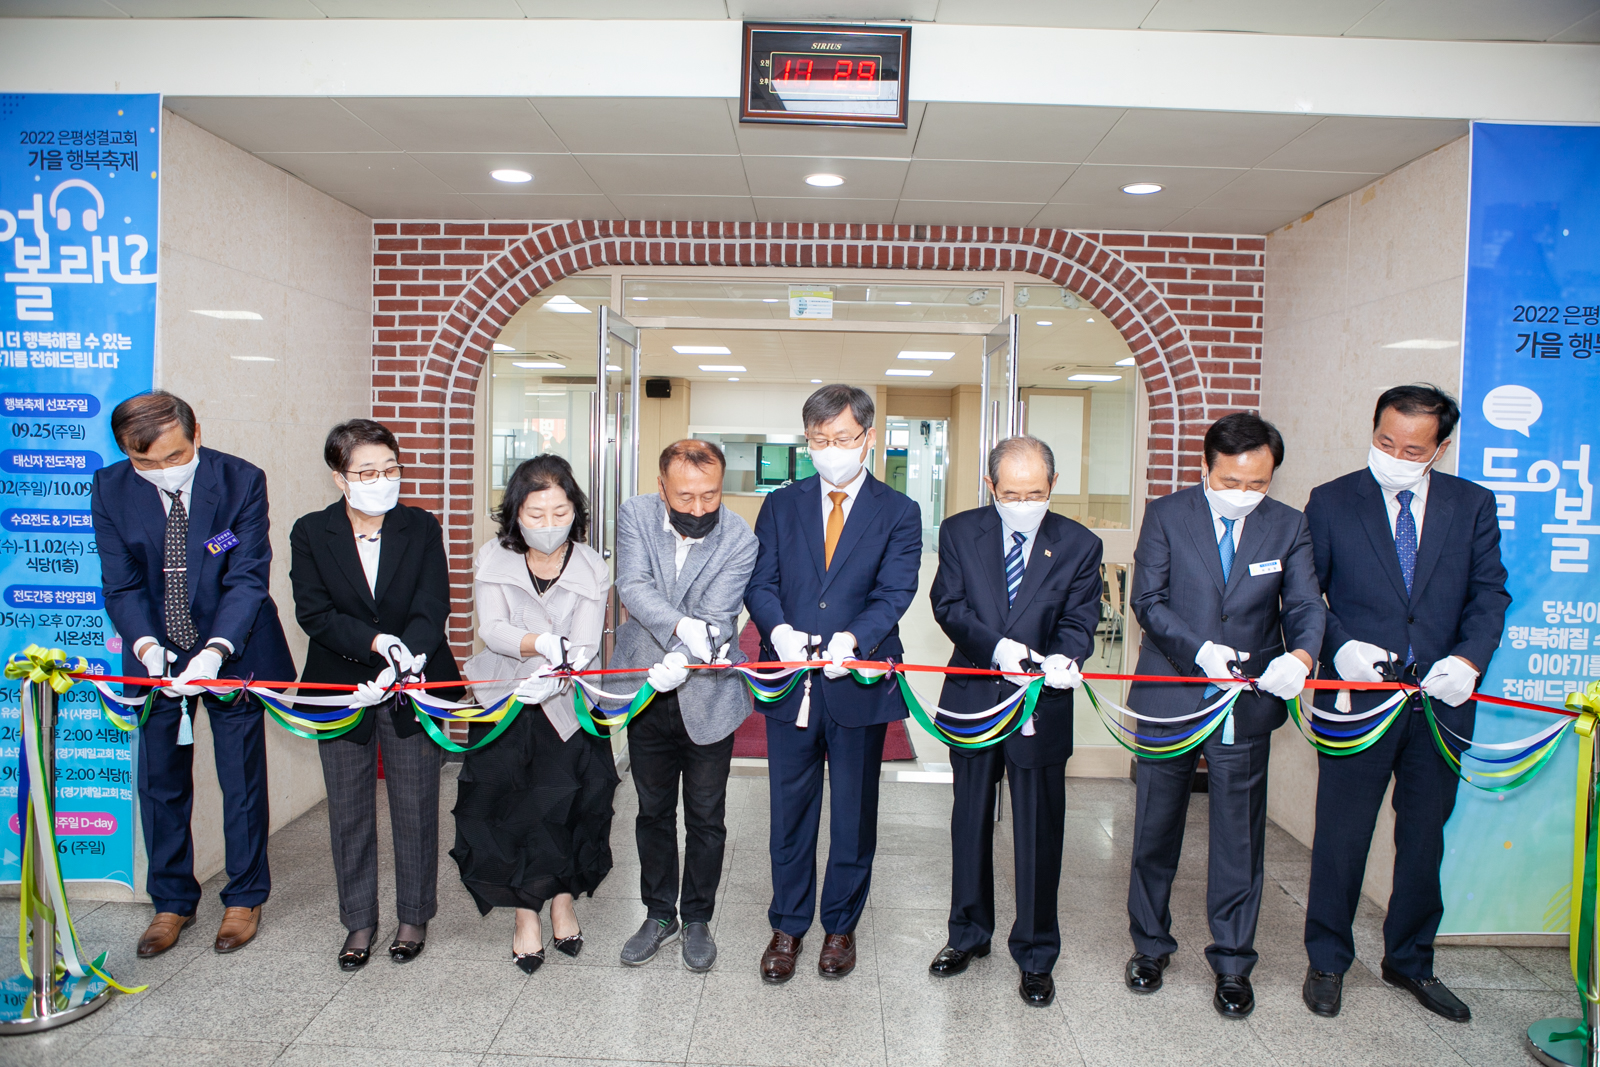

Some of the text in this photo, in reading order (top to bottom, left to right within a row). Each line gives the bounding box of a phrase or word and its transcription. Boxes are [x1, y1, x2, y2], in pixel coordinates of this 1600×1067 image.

[811, 42, 842, 50] SIRIUS
[760, 59, 770, 67] 오전
[833, 60, 876, 89] 29
[20, 129, 138, 147] 2022 은평성결교회
[29, 150, 139, 172] 가을 행복축제
[1513, 305, 1600, 326] 2022 은평
[6, 331, 20, 348] 더
[23, 331, 81, 349] 행복해질
[85, 333, 100, 350] 수
[102, 333, 132, 350] 있는
[1515, 331, 1563, 359] 가을
[30, 351, 119, 369] 전해드립니다
[4, 398, 88, 412] 행복축제 선포주일
[12, 423, 86, 441] 09.25(주일)
[13, 455, 86, 469] 태신자 전도작정
[11, 514, 93, 528] 수요전도 & 기도회
[26, 557, 78, 574] 식당(1층)
[13, 590, 96, 604] 전도간증 찬양집회
[1542, 600, 1600, 624] 당신이
[38, 613, 63, 628] 오후
[66, 615, 103, 628] 07:30
[54, 631, 105, 646] 시온성전
[1508, 625, 1589, 650] 행복해질
[1528, 653, 1600, 677] 이야기를
[63, 690, 97, 703] 10:30
[1502, 679, 1588, 702] 전해드립
[1, 707, 21, 719] 유승
[70, 708, 101, 720] (사영리
[63, 729, 93, 741] 2:00
[56, 748, 115, 760] (경기제일교회
[66, 769, 96, 781] 2:00
[60, 786, 119, 799] (경기제일교회
[55, 817, 114, 831] 주일 D-day
[71, 840, 106, 855] (주일)
